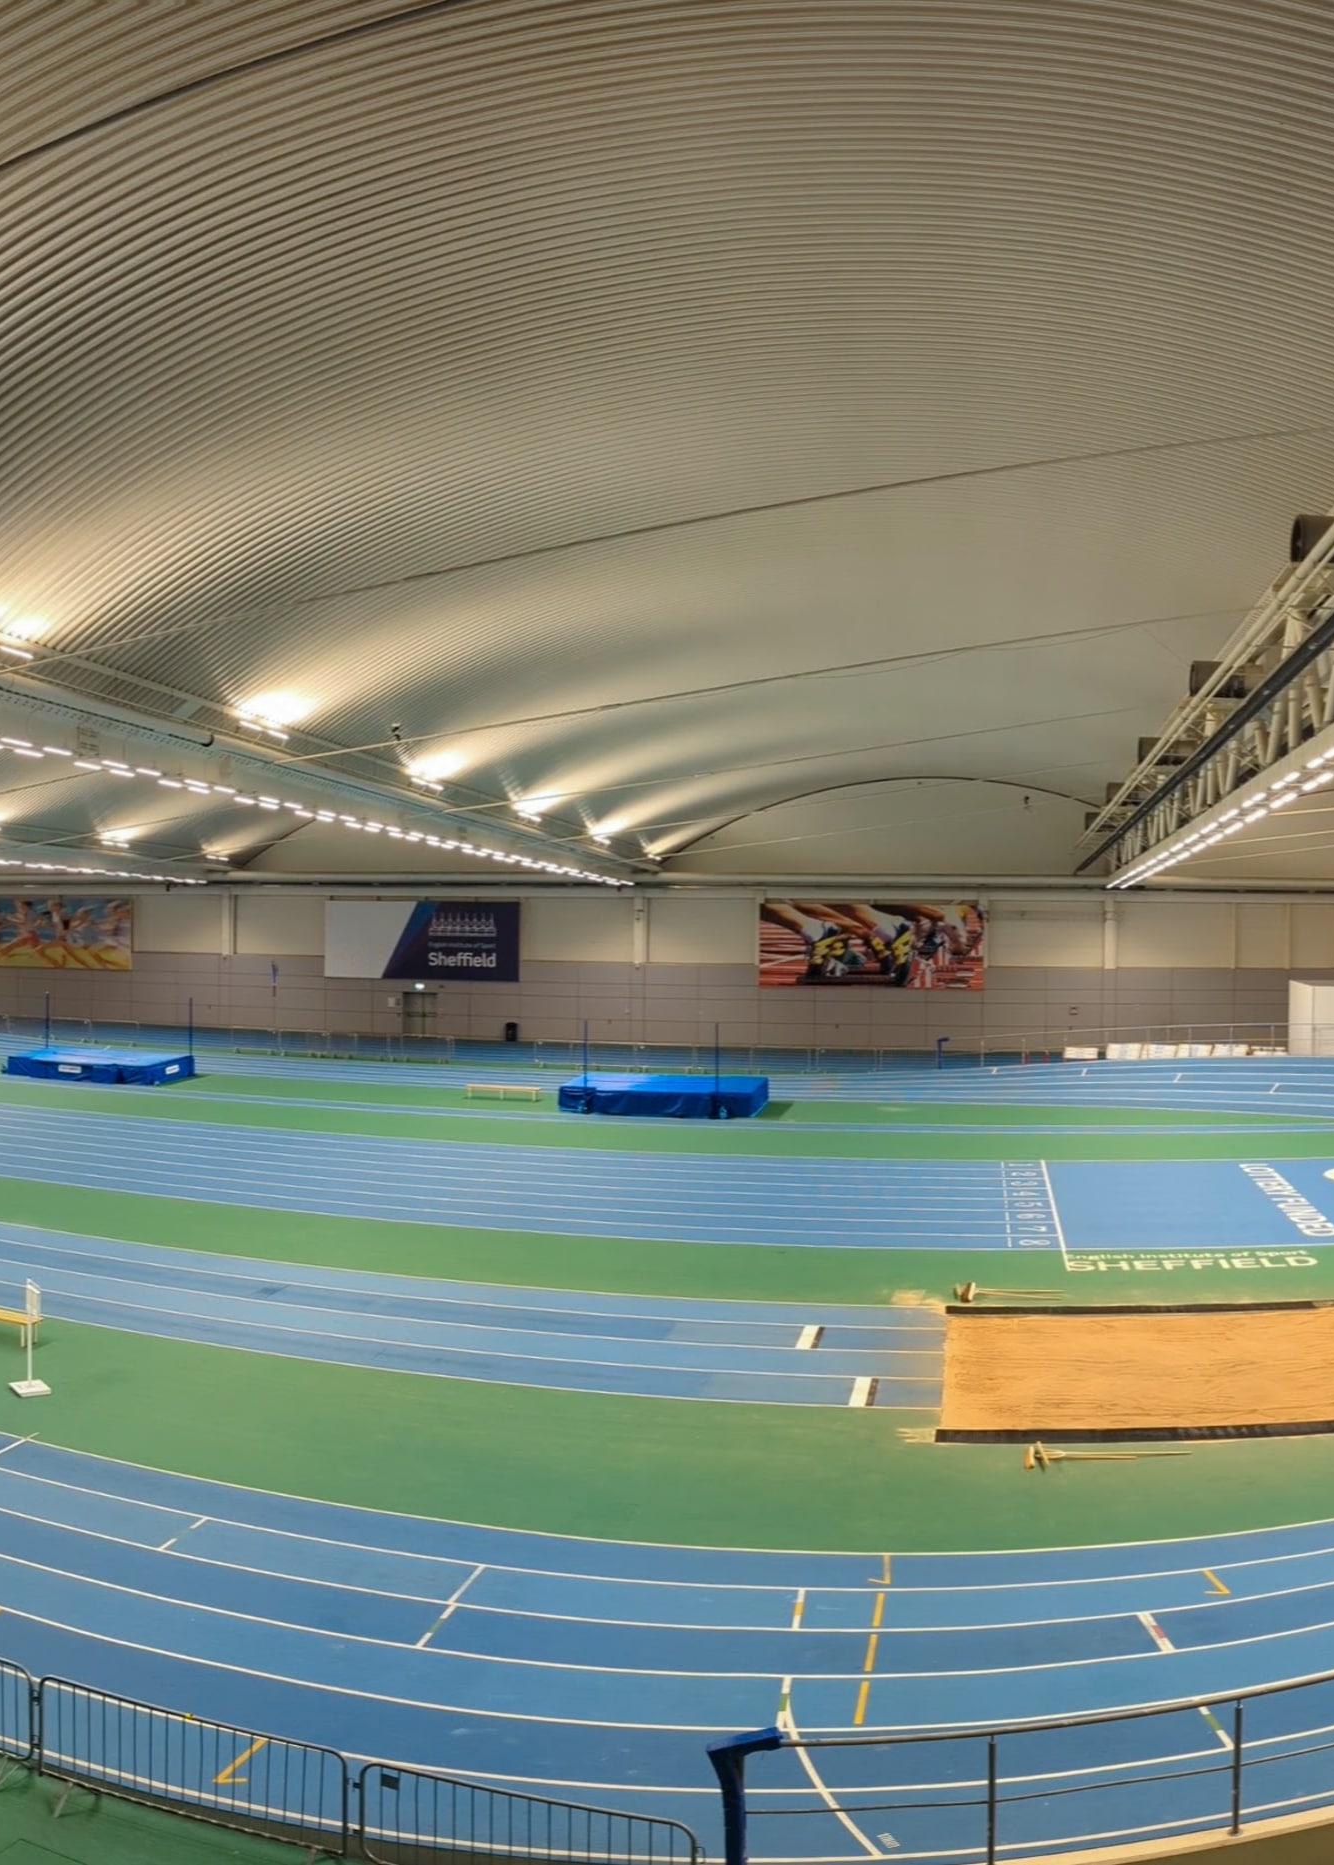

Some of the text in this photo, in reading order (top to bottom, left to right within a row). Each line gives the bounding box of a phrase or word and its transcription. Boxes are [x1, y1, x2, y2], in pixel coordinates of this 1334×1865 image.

[428, 952, 497, 968] Sheffield
[1239, 1163, 1302, 1196] LOTTERY
[1066, 1256, 1318, 1271] SHEFFIELD
